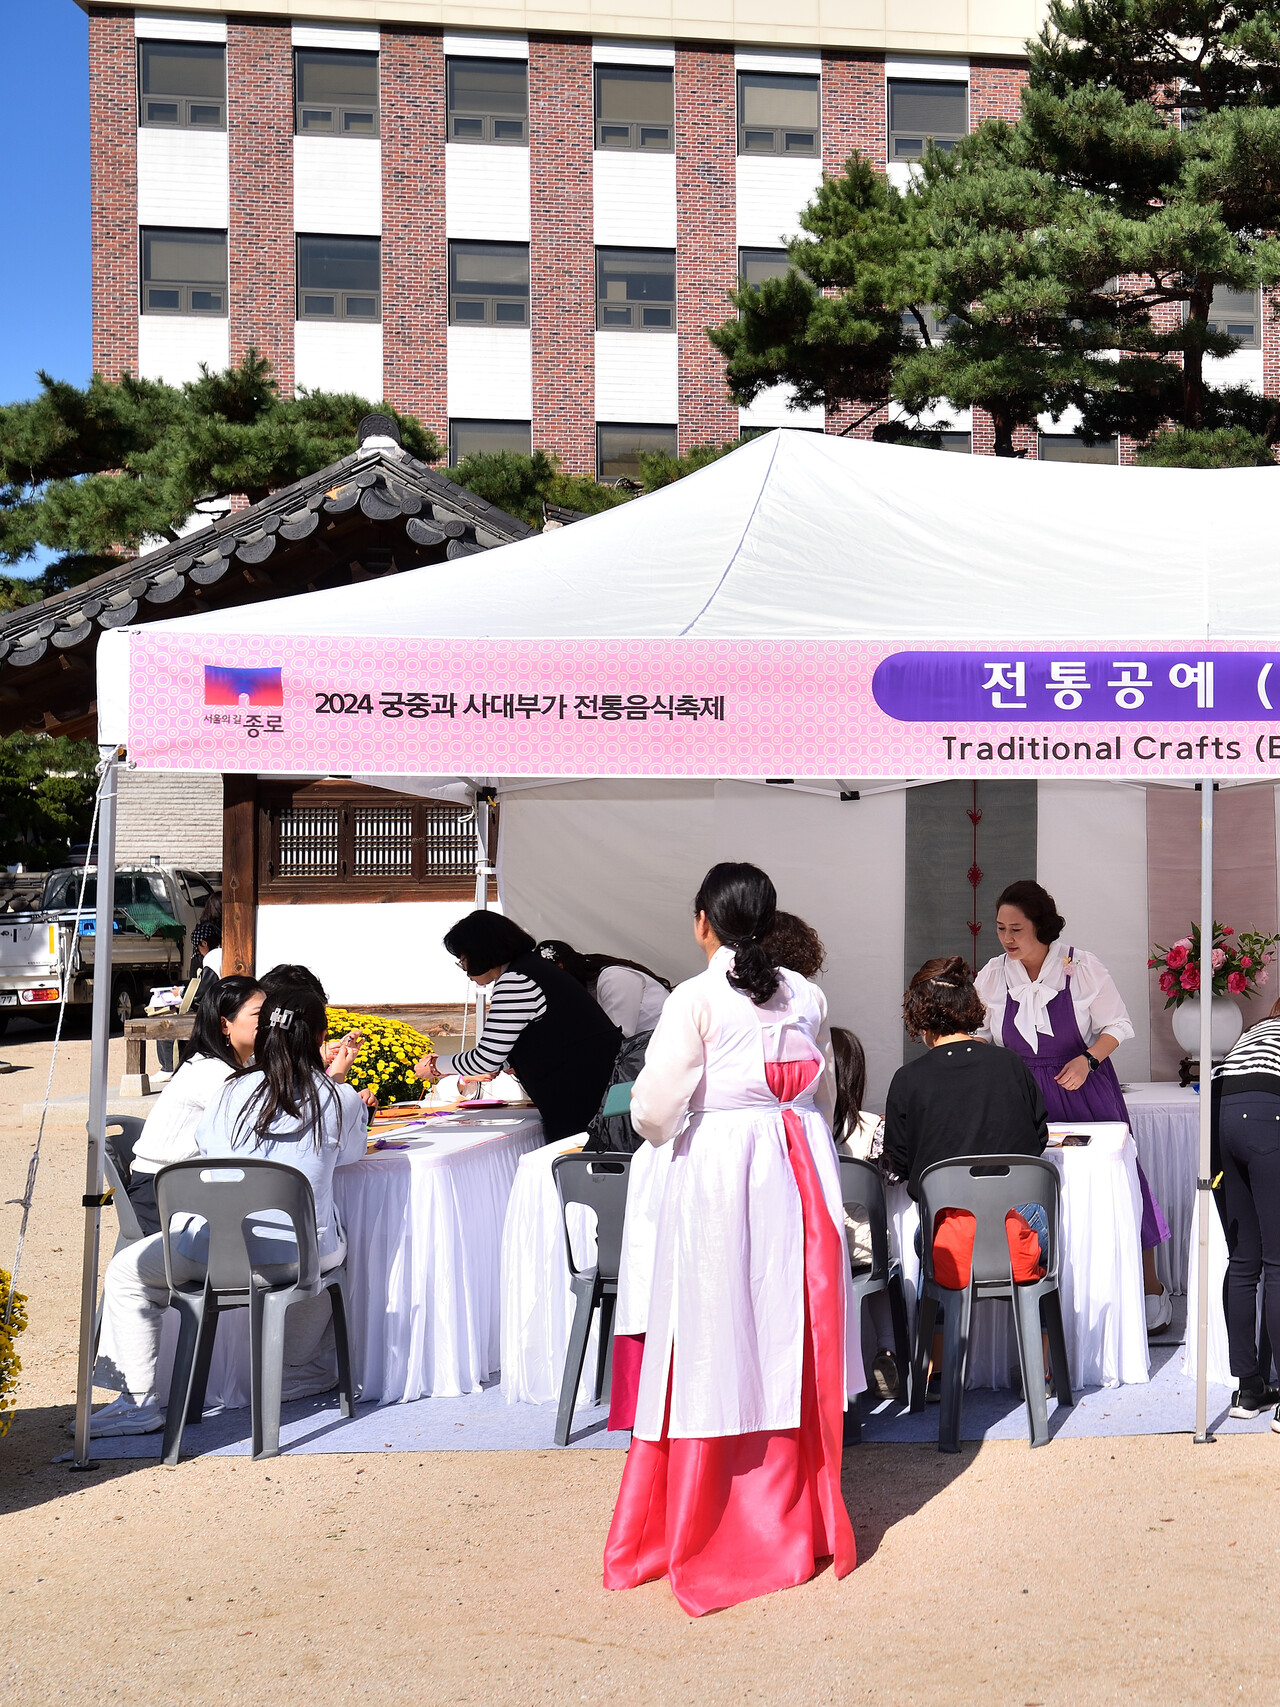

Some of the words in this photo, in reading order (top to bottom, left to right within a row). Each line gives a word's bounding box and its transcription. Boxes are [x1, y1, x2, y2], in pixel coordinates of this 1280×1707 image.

[981, 661, 1214, 710] 전통공예
[315, 692, 374, 715] 2024
[378, 692, 458, 719] 궁중과
[462, 693, 568, 720] 사대부가
[573, 694, 725, 721] 전통음식축제
[203, 713, 231, 725] 서울의
[232, 714, 242, 725] 길
[242, 714, 284, 739] 종로
[942, 736, 1121, 761] Traditional
[1133, 735, 1241, 760] Crafts
